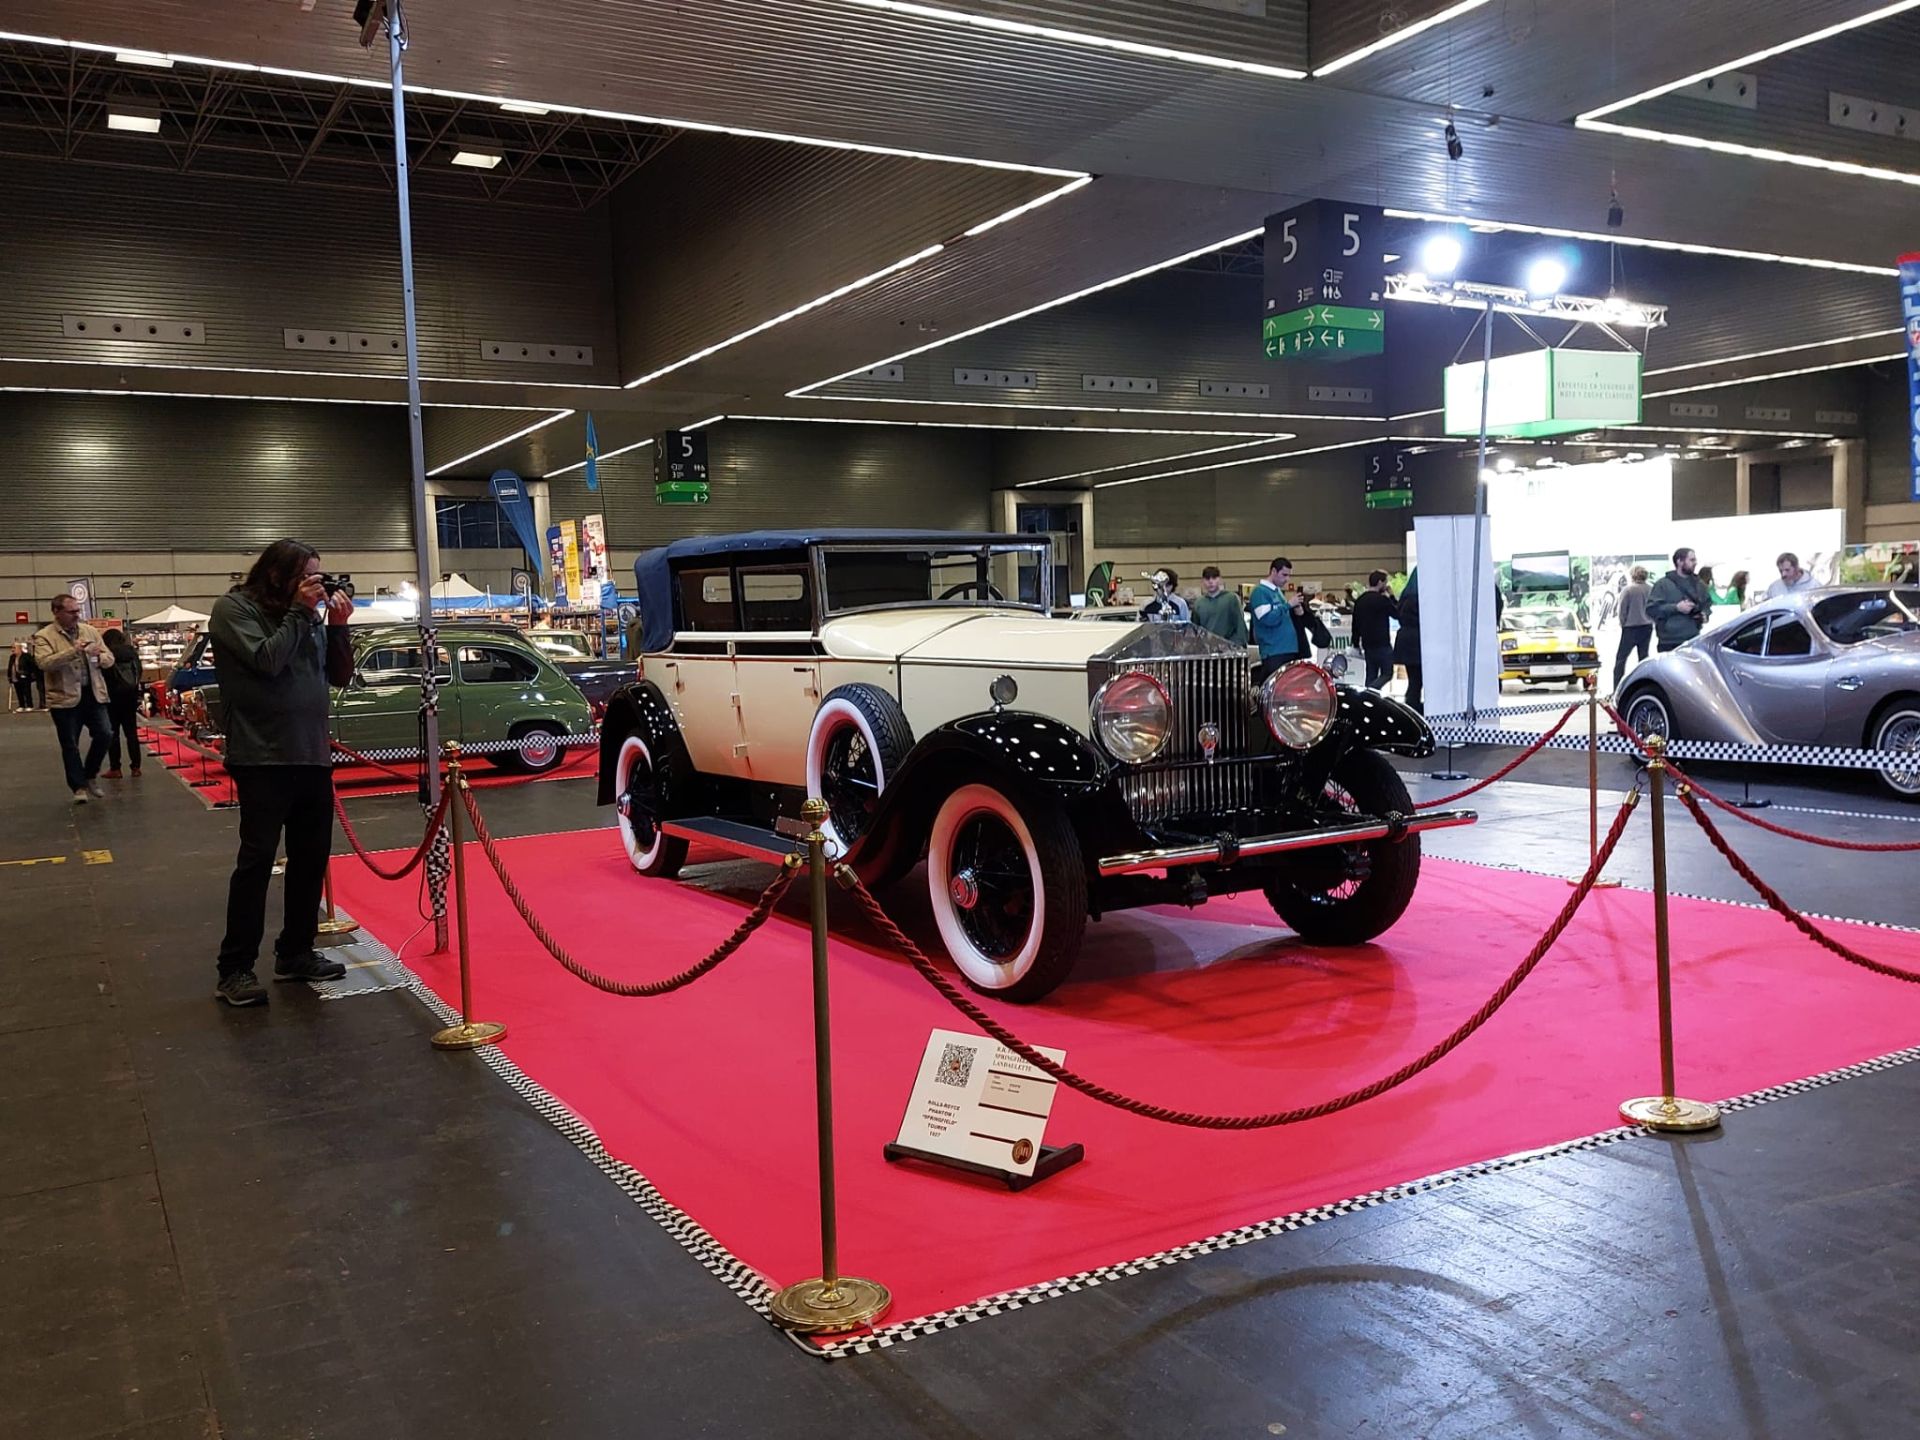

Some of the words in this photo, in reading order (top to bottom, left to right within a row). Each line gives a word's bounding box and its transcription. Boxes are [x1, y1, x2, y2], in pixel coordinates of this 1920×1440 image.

[1283, 218, 1298, 263] 5
[1342, 213, 1360, 256] 5
[681, 436, 693, 457] 5
[1373, 456, 1380, 473] 5
[1397, 455, 1404, 472] 5
[928, 1107, 952, 1117] PHANTOM
